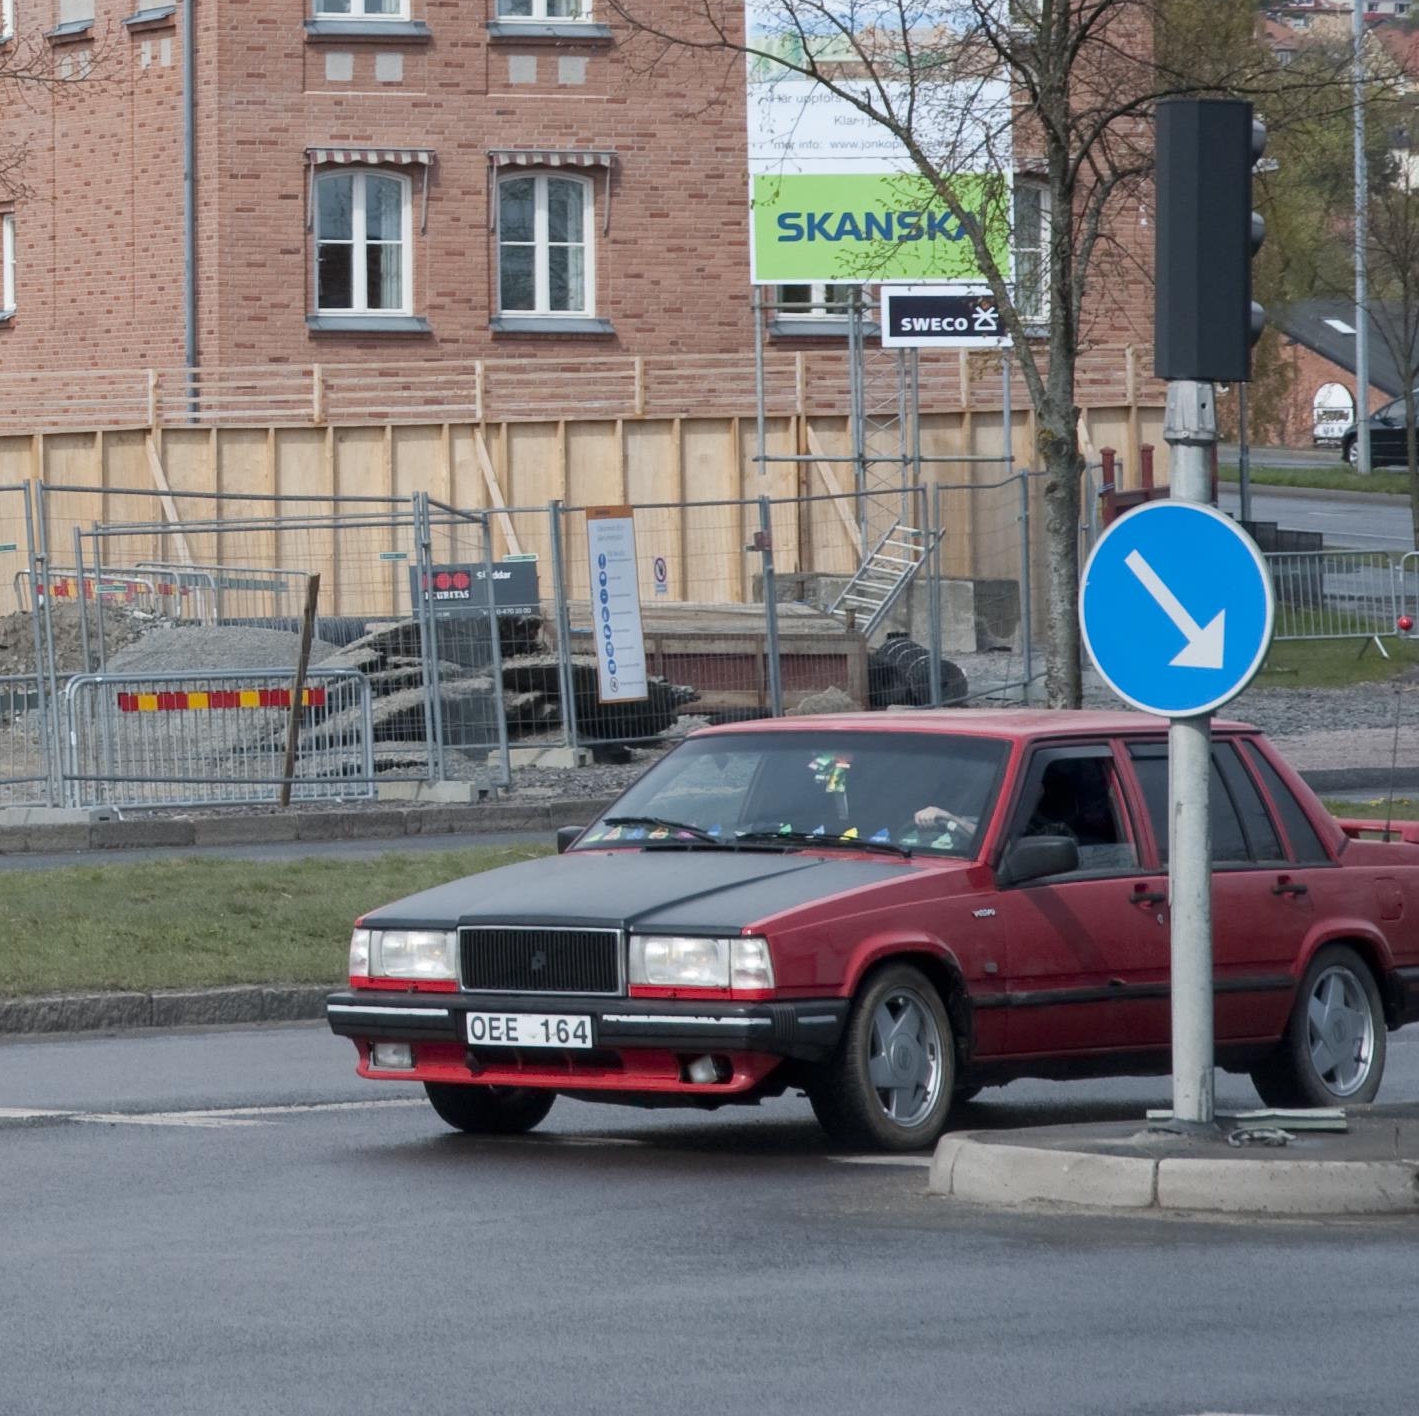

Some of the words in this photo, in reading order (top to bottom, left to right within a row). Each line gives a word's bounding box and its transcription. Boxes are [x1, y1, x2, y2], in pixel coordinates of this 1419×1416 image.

[834, 115, 858, 126] Klar
[901, 317, 969, 331] SWECO
[476, 570, 512, 580] Sddar
[424, 590, 470, 601] EURITAS
[471, 1015, 519, 1042] OEE
[541, 1018, 588, 1045] 164
